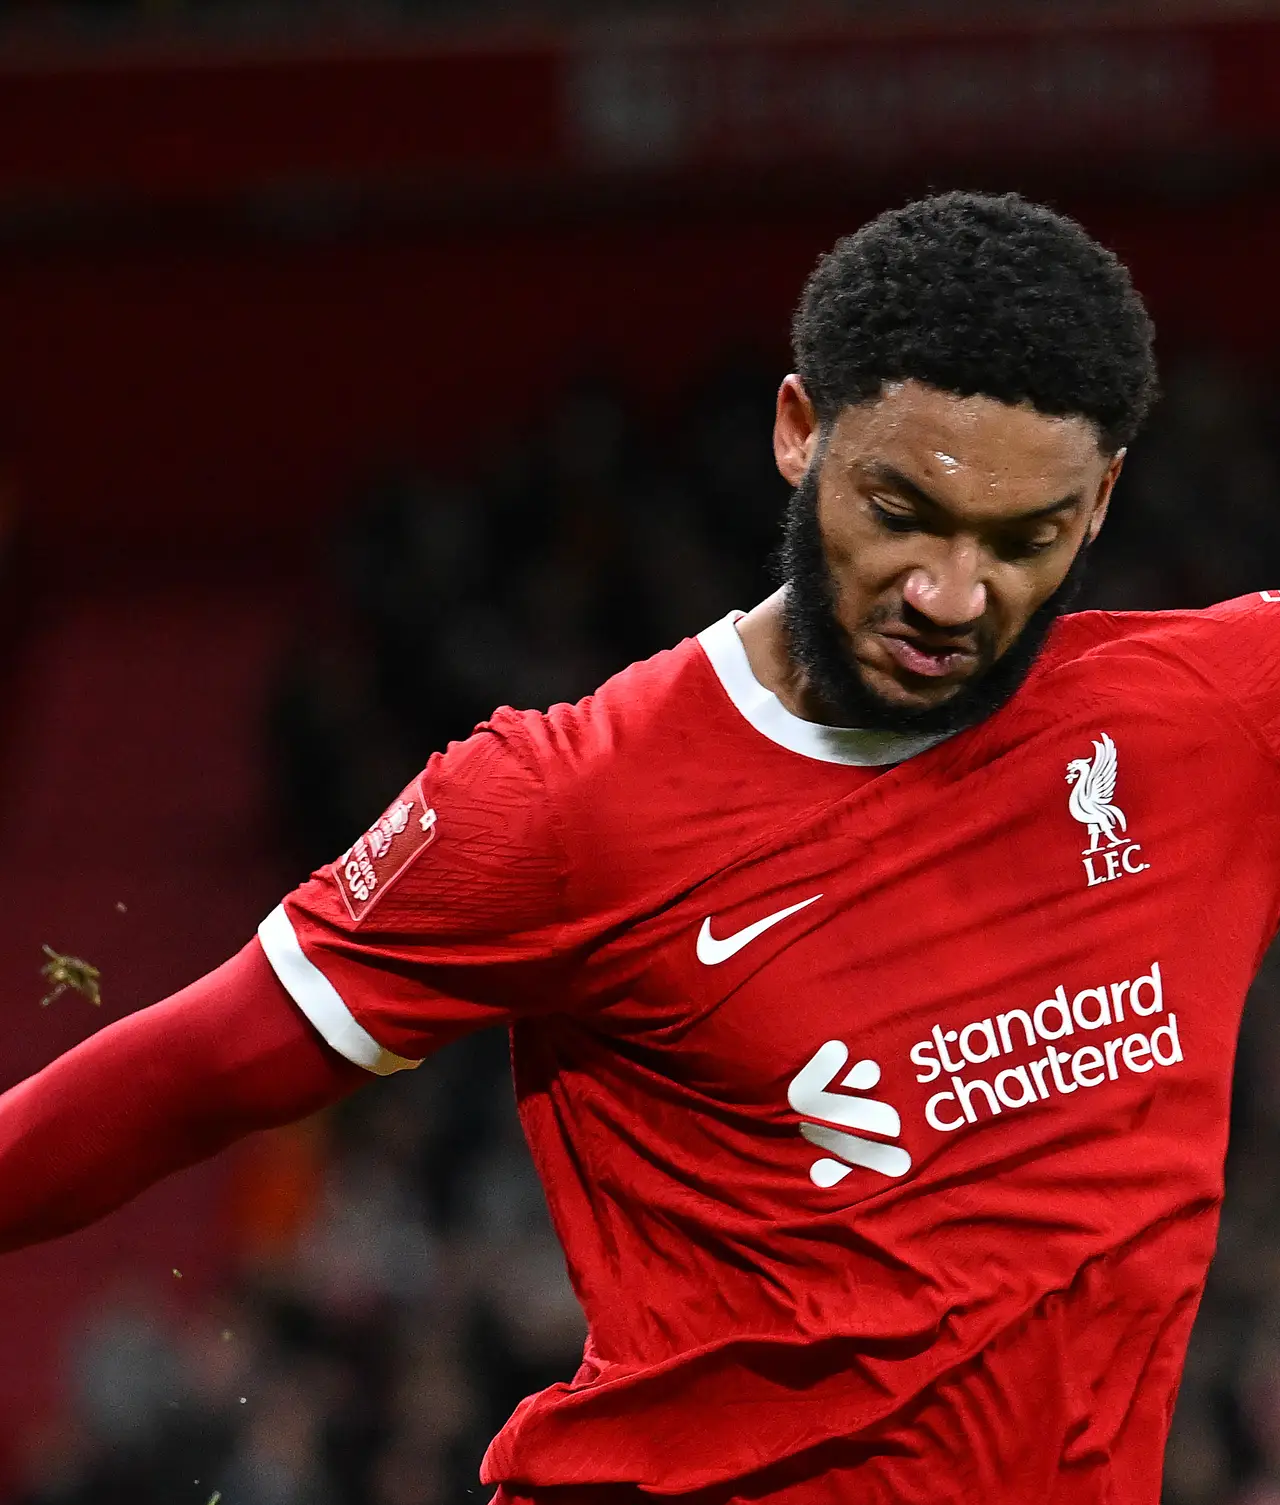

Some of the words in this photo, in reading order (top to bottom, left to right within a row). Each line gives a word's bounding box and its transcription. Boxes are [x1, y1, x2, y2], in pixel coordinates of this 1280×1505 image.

[345, 861, 369, 900] CUP
[910, 962, 1163, 1083] standard
[925, 1012, 1184, 1132] chartered
